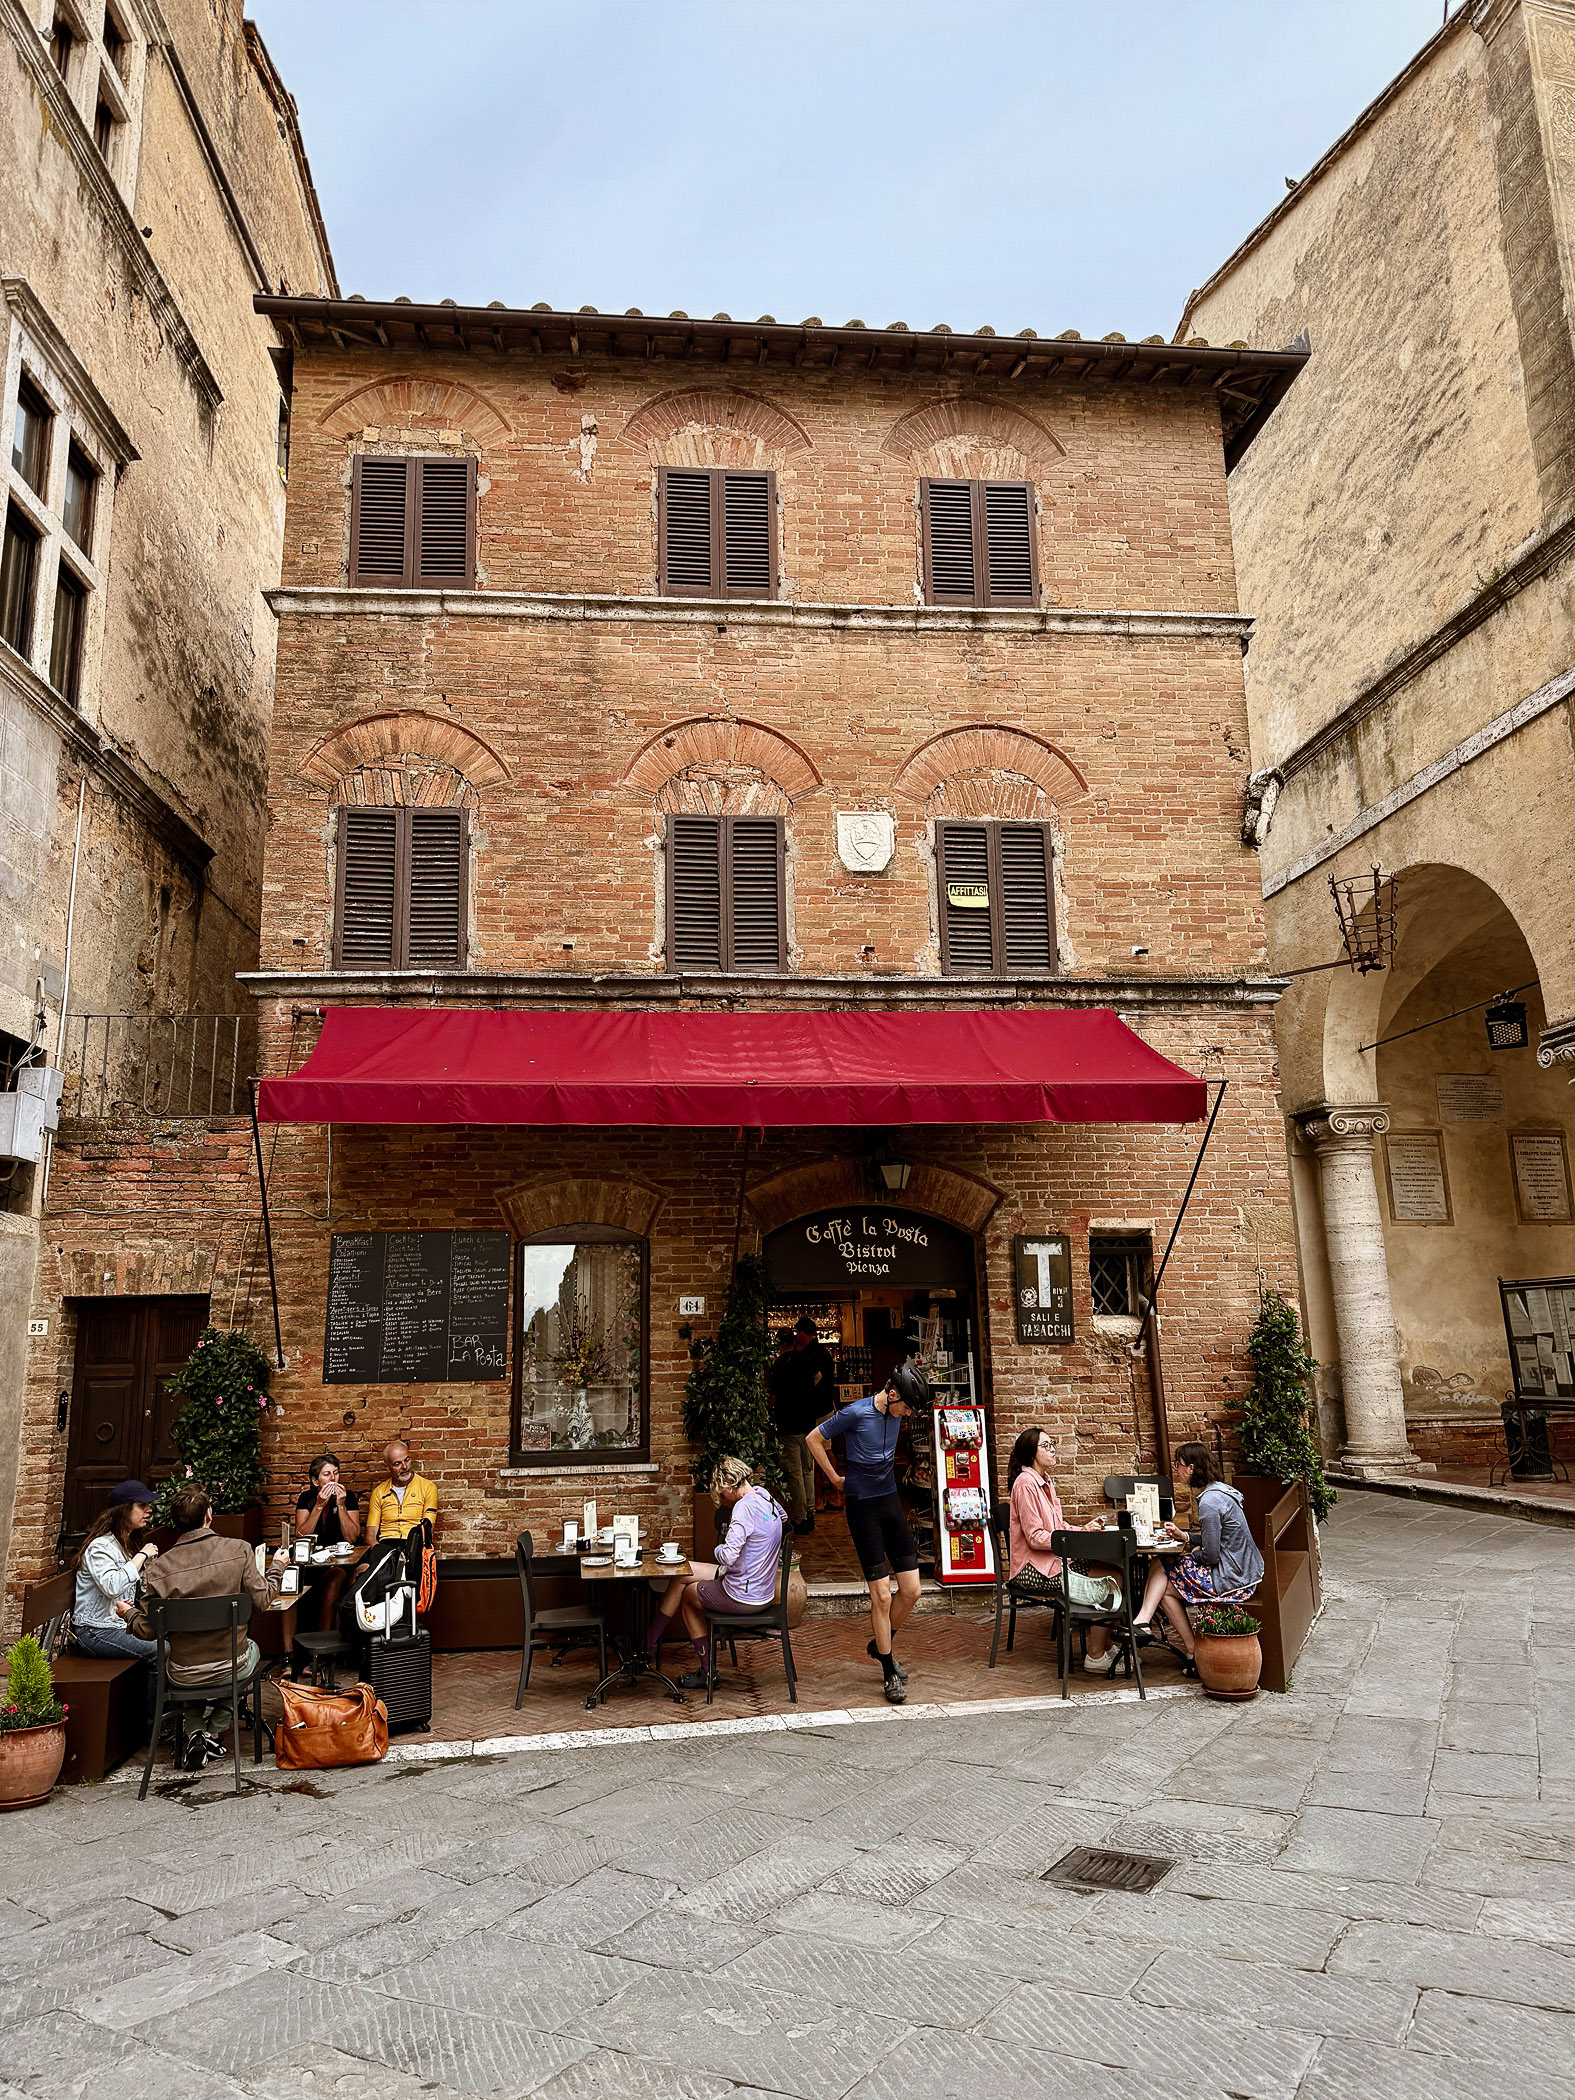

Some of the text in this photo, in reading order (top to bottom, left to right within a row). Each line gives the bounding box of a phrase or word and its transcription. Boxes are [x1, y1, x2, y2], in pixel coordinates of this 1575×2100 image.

[950, 886, 987, 896] AFFITTASI
[806, 1216, 928, 1246] Caffè la Posta
[336, 1235, 373, 1247] Breakfast
[838, 1241, 898, 1259] Bistrot
[846, 1261, 890, 1275] Pienza
[1023, 1242, 1063, 1308] T
[1030, 1313, 1060, 1322] SALI E
[30, 1323, 44, 1333] 55
[1021, 1324, 1071, 1337] TABACCHI
[452, 1335, 483, 1349] BAR
[450, 1350, 471, 1362] LA
[475, 1345, 507, 1367] Posta
